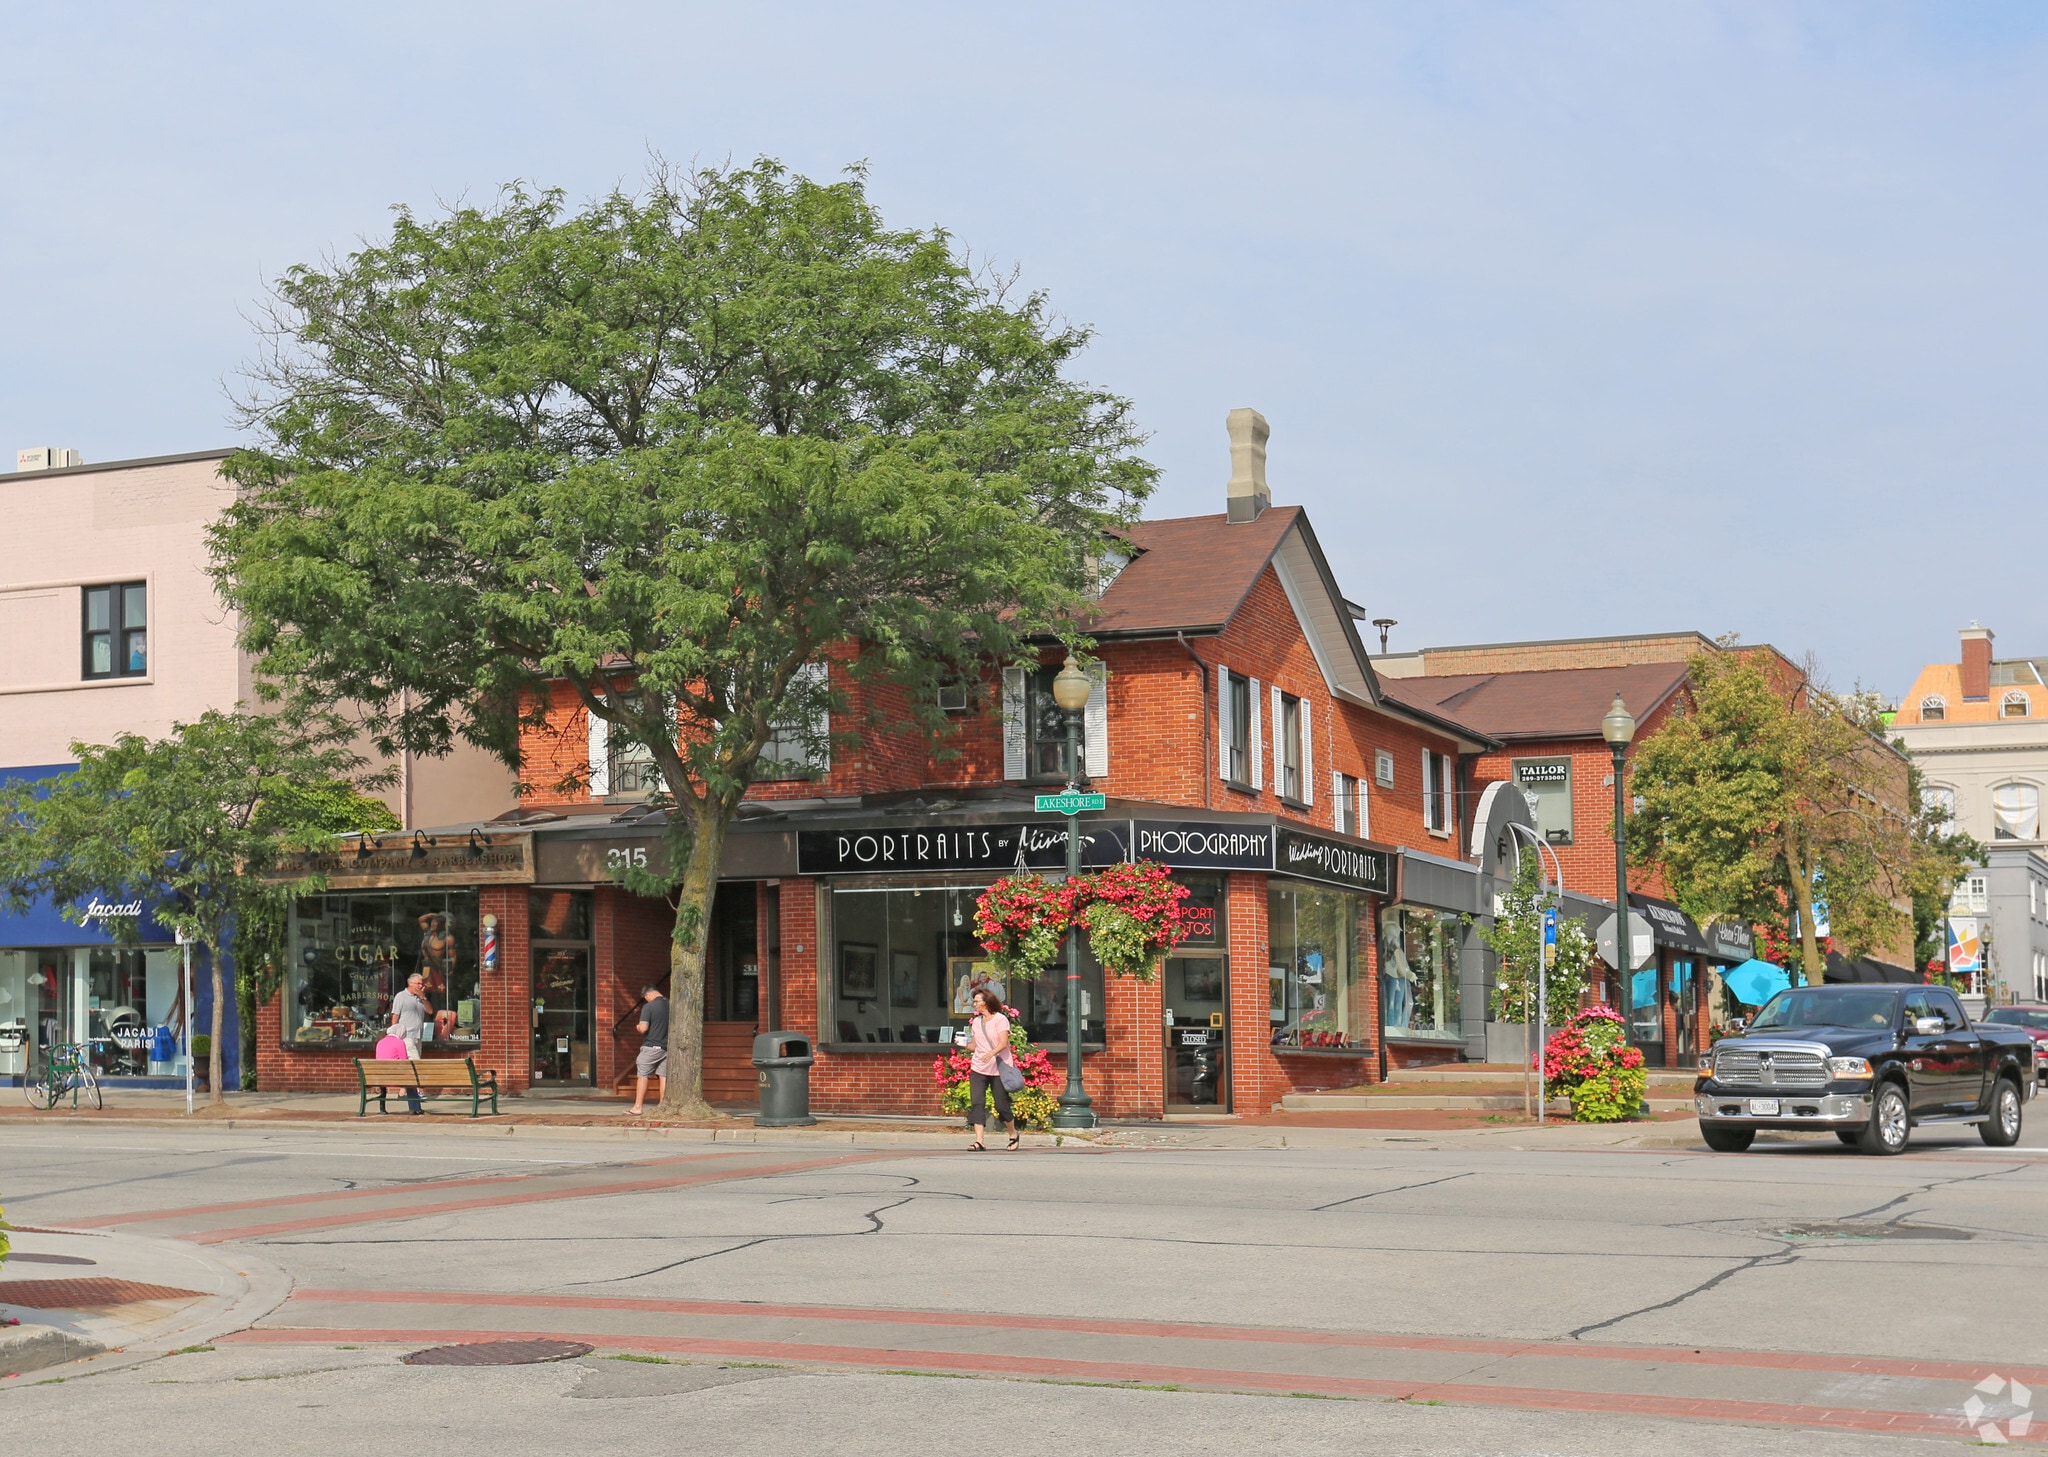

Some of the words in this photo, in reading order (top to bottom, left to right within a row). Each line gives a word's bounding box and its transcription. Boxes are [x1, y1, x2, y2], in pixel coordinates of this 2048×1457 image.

[1520, 765, 1565, 775] TAILOR
[1037, 797, 1090, 809] LAKESHORE
[839, 832, 991, 862] PORTRAITS
[998, 839, 1009, 848] BY
[1141, 830, 1268, 856] PHOTOGRAPHY
[349, 855, 412, 870] COMPANY
[434, 853, 515, 866] BARBERSHOP
[607, 847, 648, 869] 315
[1288, 842, 1324, 865] Wedding
[1324, 846, 1376, 881] PORTRAITS
[1181, 906, 1214, 919] PORT
[335, 944, 399, 961] CIGAR
[117, 1027, 158, 1037] JACADI
[1182, 1035, 1207, 1044] CLOSED
